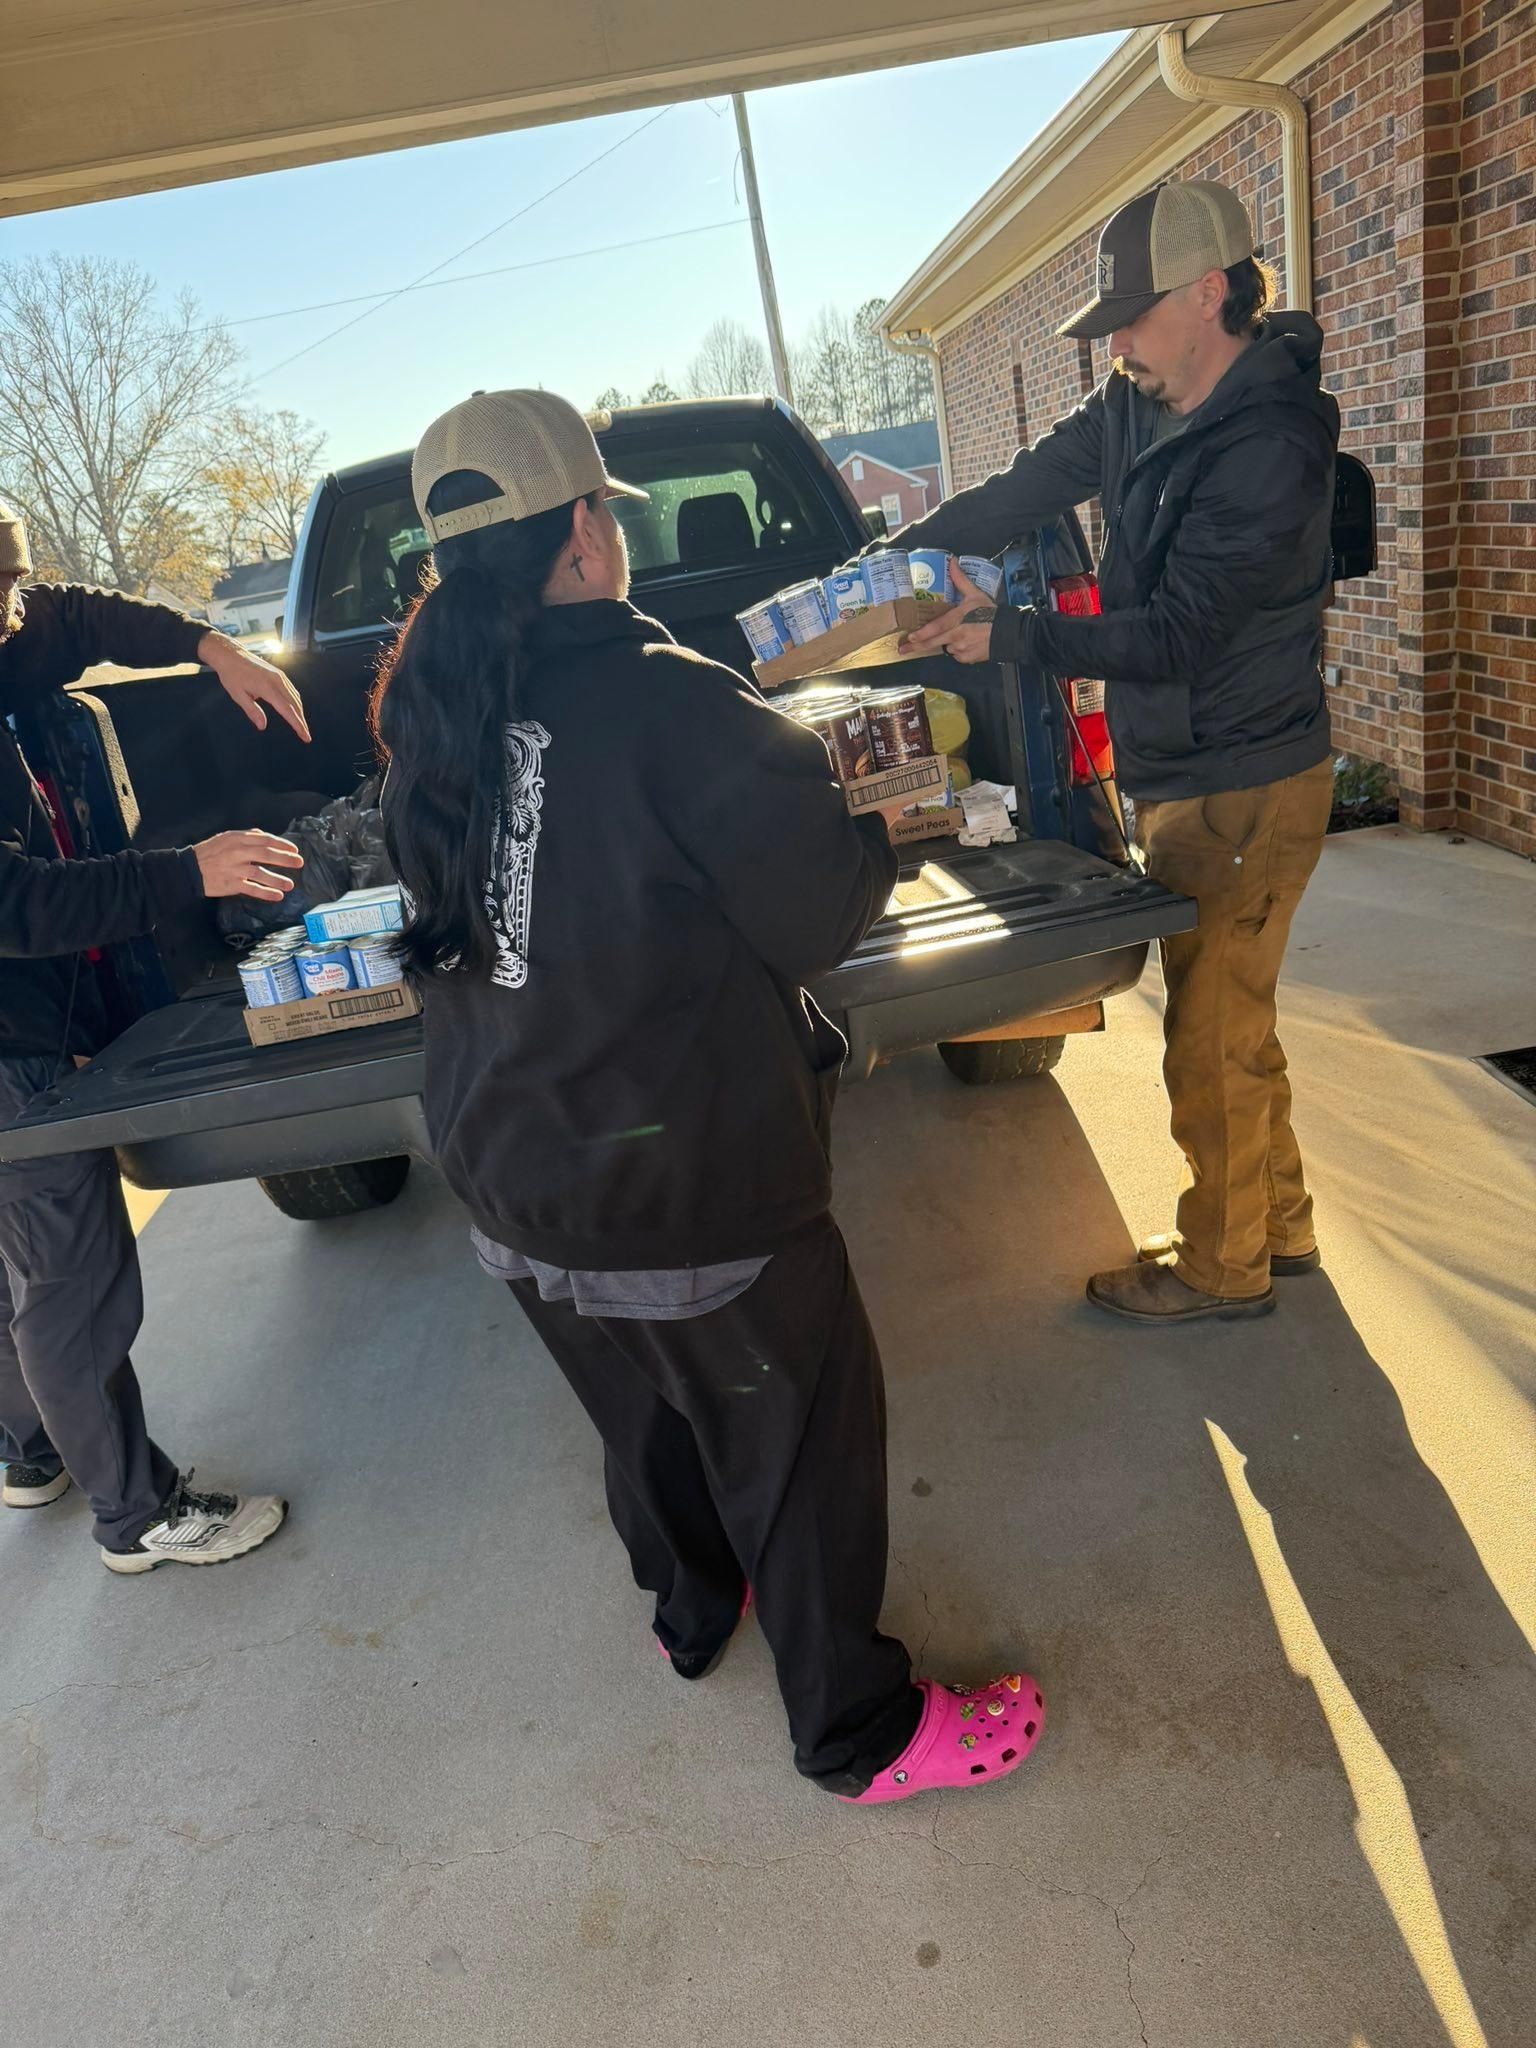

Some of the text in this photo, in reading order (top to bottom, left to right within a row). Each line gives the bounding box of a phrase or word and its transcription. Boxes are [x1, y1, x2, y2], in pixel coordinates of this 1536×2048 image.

[840, 600, 858, 608] Green
[895, 818, 950, 836] Sweet Peas
